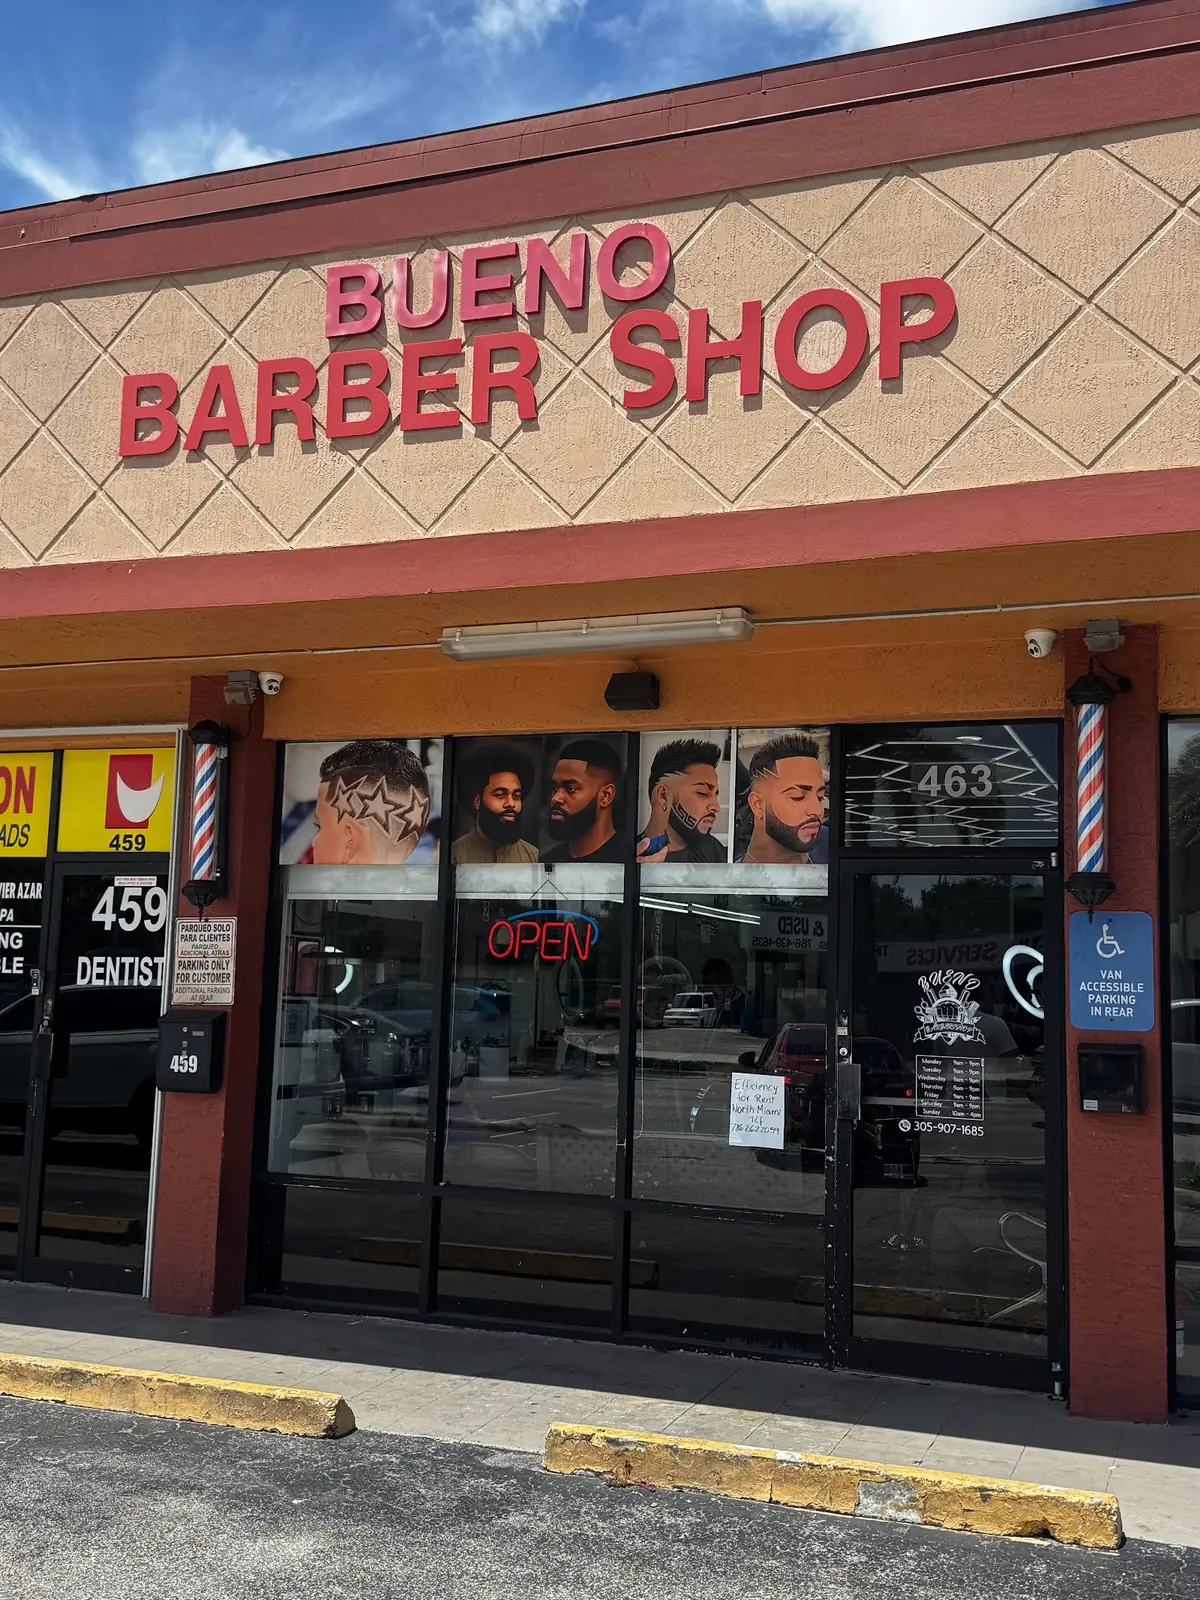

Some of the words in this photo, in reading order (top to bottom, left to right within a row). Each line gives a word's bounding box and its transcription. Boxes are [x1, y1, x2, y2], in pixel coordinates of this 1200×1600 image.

[325, 222, 672, 337] BUENO
[119, 331, 541, 456] BARBER
[610, 276, 957, 408] SHOP
[917, 764, 993, 798] 463
[109, 834, 146, 851] 459
[17, 882, 43, 899] AZAR
[91, 886, 167, 933] 459
[181, 924, 211, 933] PARQUEO
[213, 924, 231, 932] SOLO
[180, 934, 198, 942] PARA
[199, 933, 231, 942] CLIENTES
[487, 920, 592, 960] OPEN
[0, 956, 24, 974] LE
[178, 960, 210, 971] PARKING
[211, 960, 230, 970] ONLY
[76, 956, 165, 987] DENTIST
[1100, 969, 1122, 980] VAN
[176, 973, 191, 983] FOR
[192, 973, 231, 983] CUSTOMER
[917, 969, 981, 993] BUENO
[1079, 981, 1144, 993] ACCESSIBLE
[1088, 993, 1136, 1005] PARKING
[1090, 1006, 1102, 1016] IN
[1105, 1006, 1134, 1017] REAR
[169, 1054, 198, 1073] 459
[922, 1066, 942, 1074] Tuesday
[917, 1074, 946, 1083] Wednesday
[920, 1083, 943, 1091] Thursday
[737, 1092, 750, 1102] for
[754, 1094, 777, 1104] Rent
[732, 1104, 755, 1114] North
[757, 1105, 781, 1116] Miami
[913, 1120, 985, 1136] 305-907-1685
